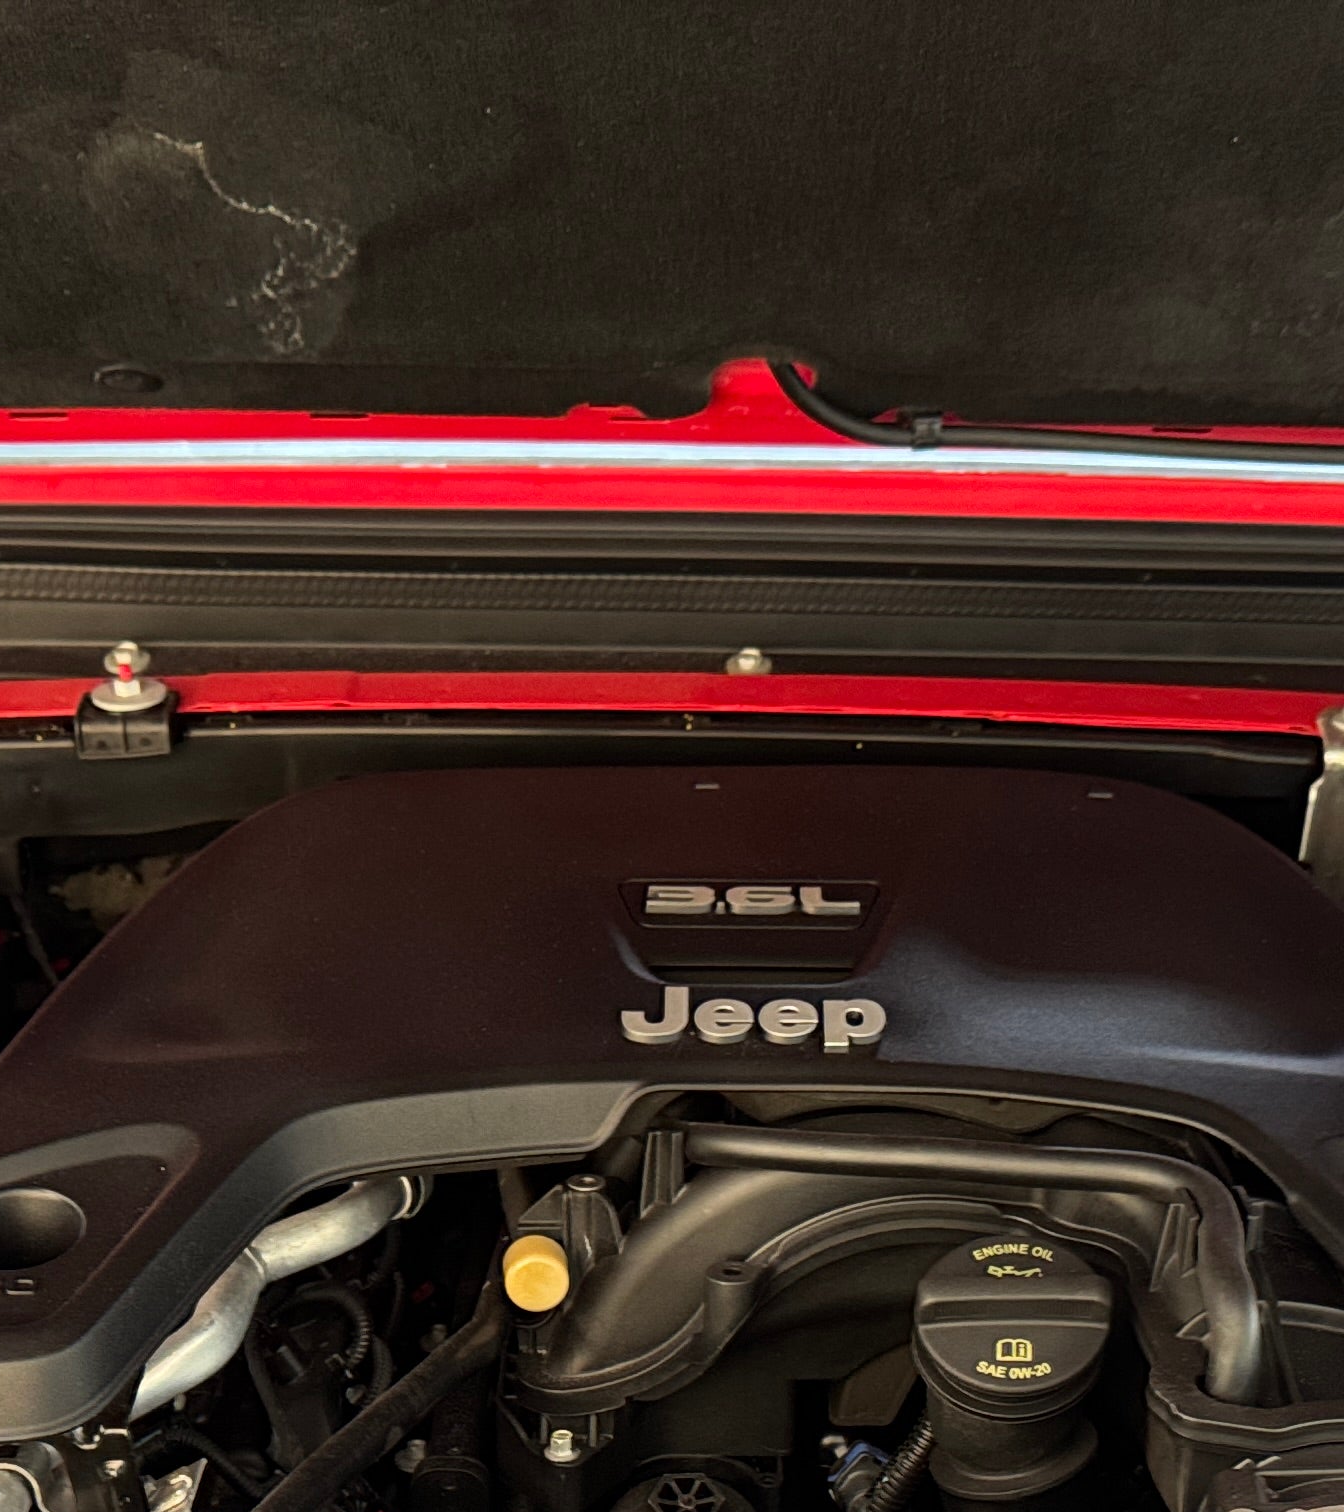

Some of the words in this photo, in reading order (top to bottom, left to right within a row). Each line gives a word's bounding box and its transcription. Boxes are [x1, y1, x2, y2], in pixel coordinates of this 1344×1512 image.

[645, 885, 861, 915] 3.6L
[620, 985, 887, 1053] Jeep
[972, 1243, 1029, 1262] ENGINE
[1031, 1246, 1055, 1262] OIL
[975, 1361, 1007, 1379] SAE
[1008, 1362, 1052, 1380] 0W-20
